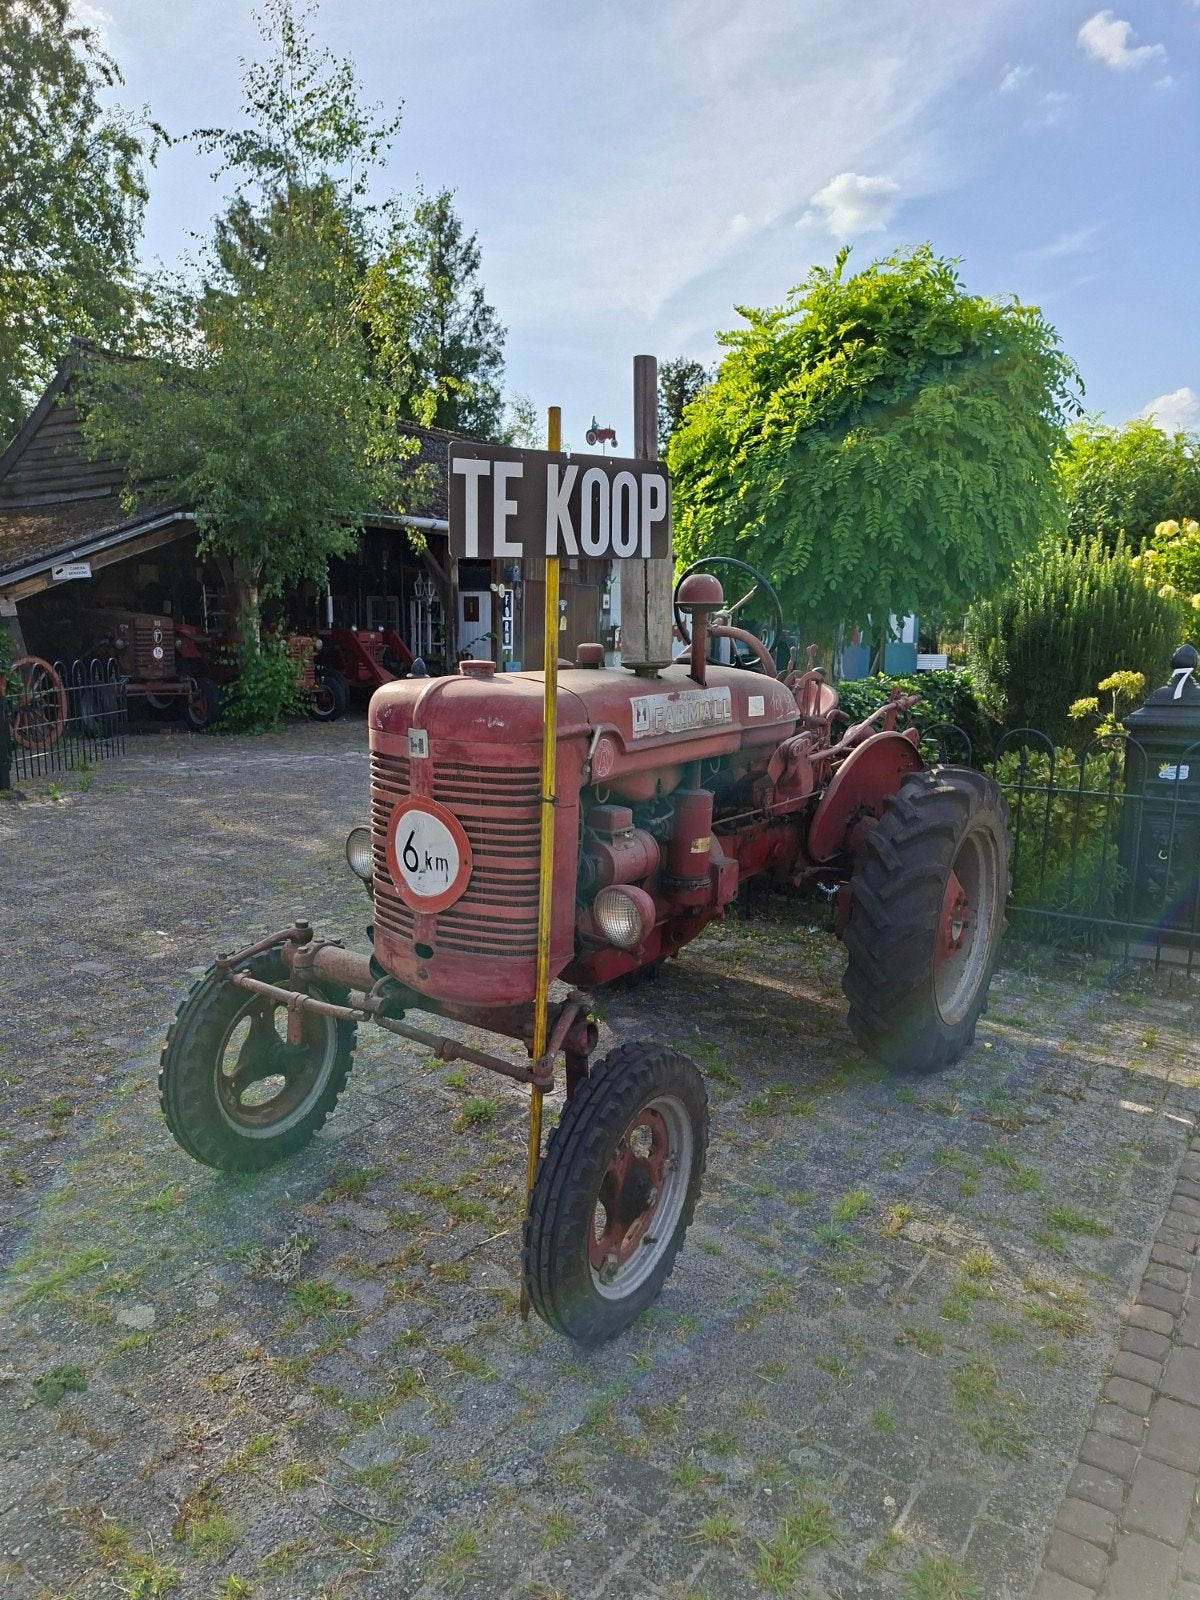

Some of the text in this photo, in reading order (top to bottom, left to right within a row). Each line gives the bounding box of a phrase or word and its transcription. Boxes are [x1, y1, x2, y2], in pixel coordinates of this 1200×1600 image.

[452, 457, 667, 558] TE KOOP
[1171, 667, 1194, 700] 7
[655, 699, 731, 729] FARMALL
[403, 830, 449, 872] 6 km
